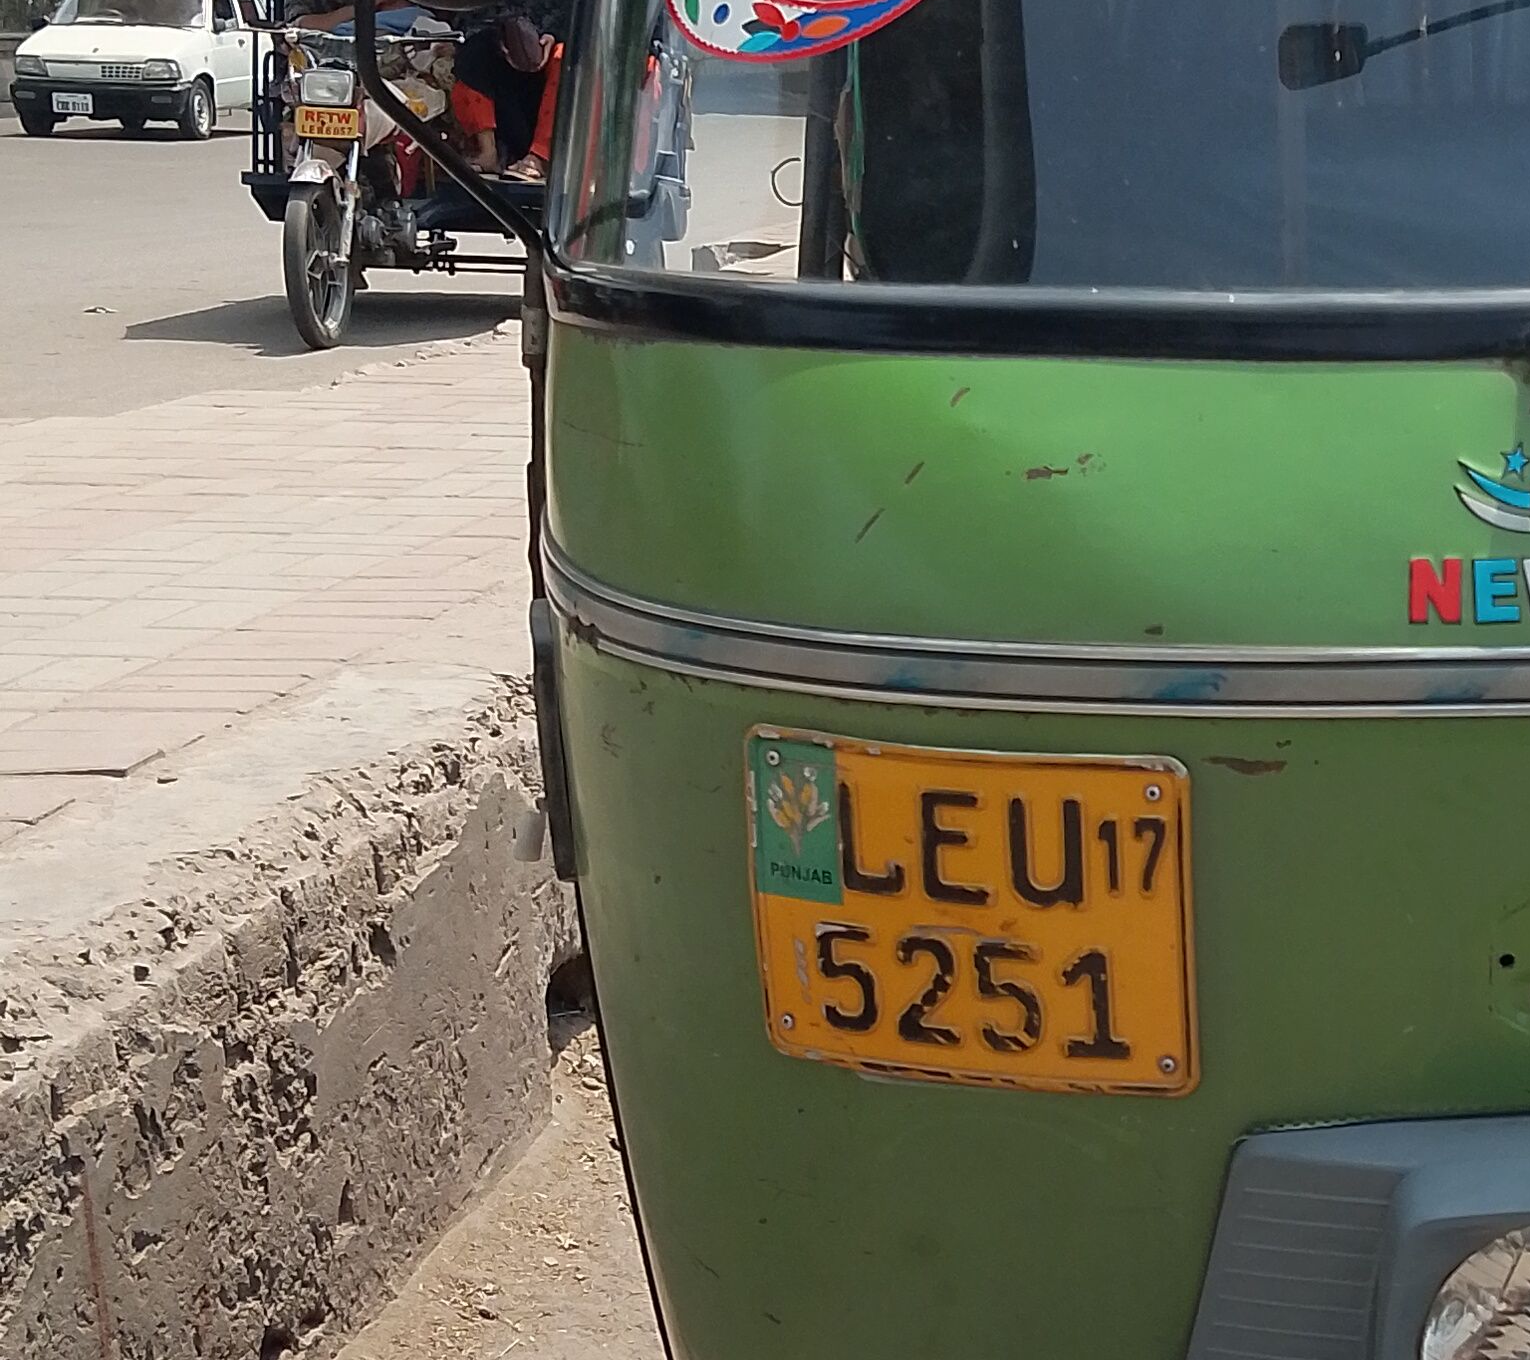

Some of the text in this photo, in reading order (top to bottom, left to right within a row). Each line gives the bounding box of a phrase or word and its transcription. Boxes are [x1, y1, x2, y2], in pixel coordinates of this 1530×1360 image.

[769, 861, 834, 886] PUNJAB
[837, 780, 1168, 908] LEU 17
[814, 921, 1132, 1061] 5251
